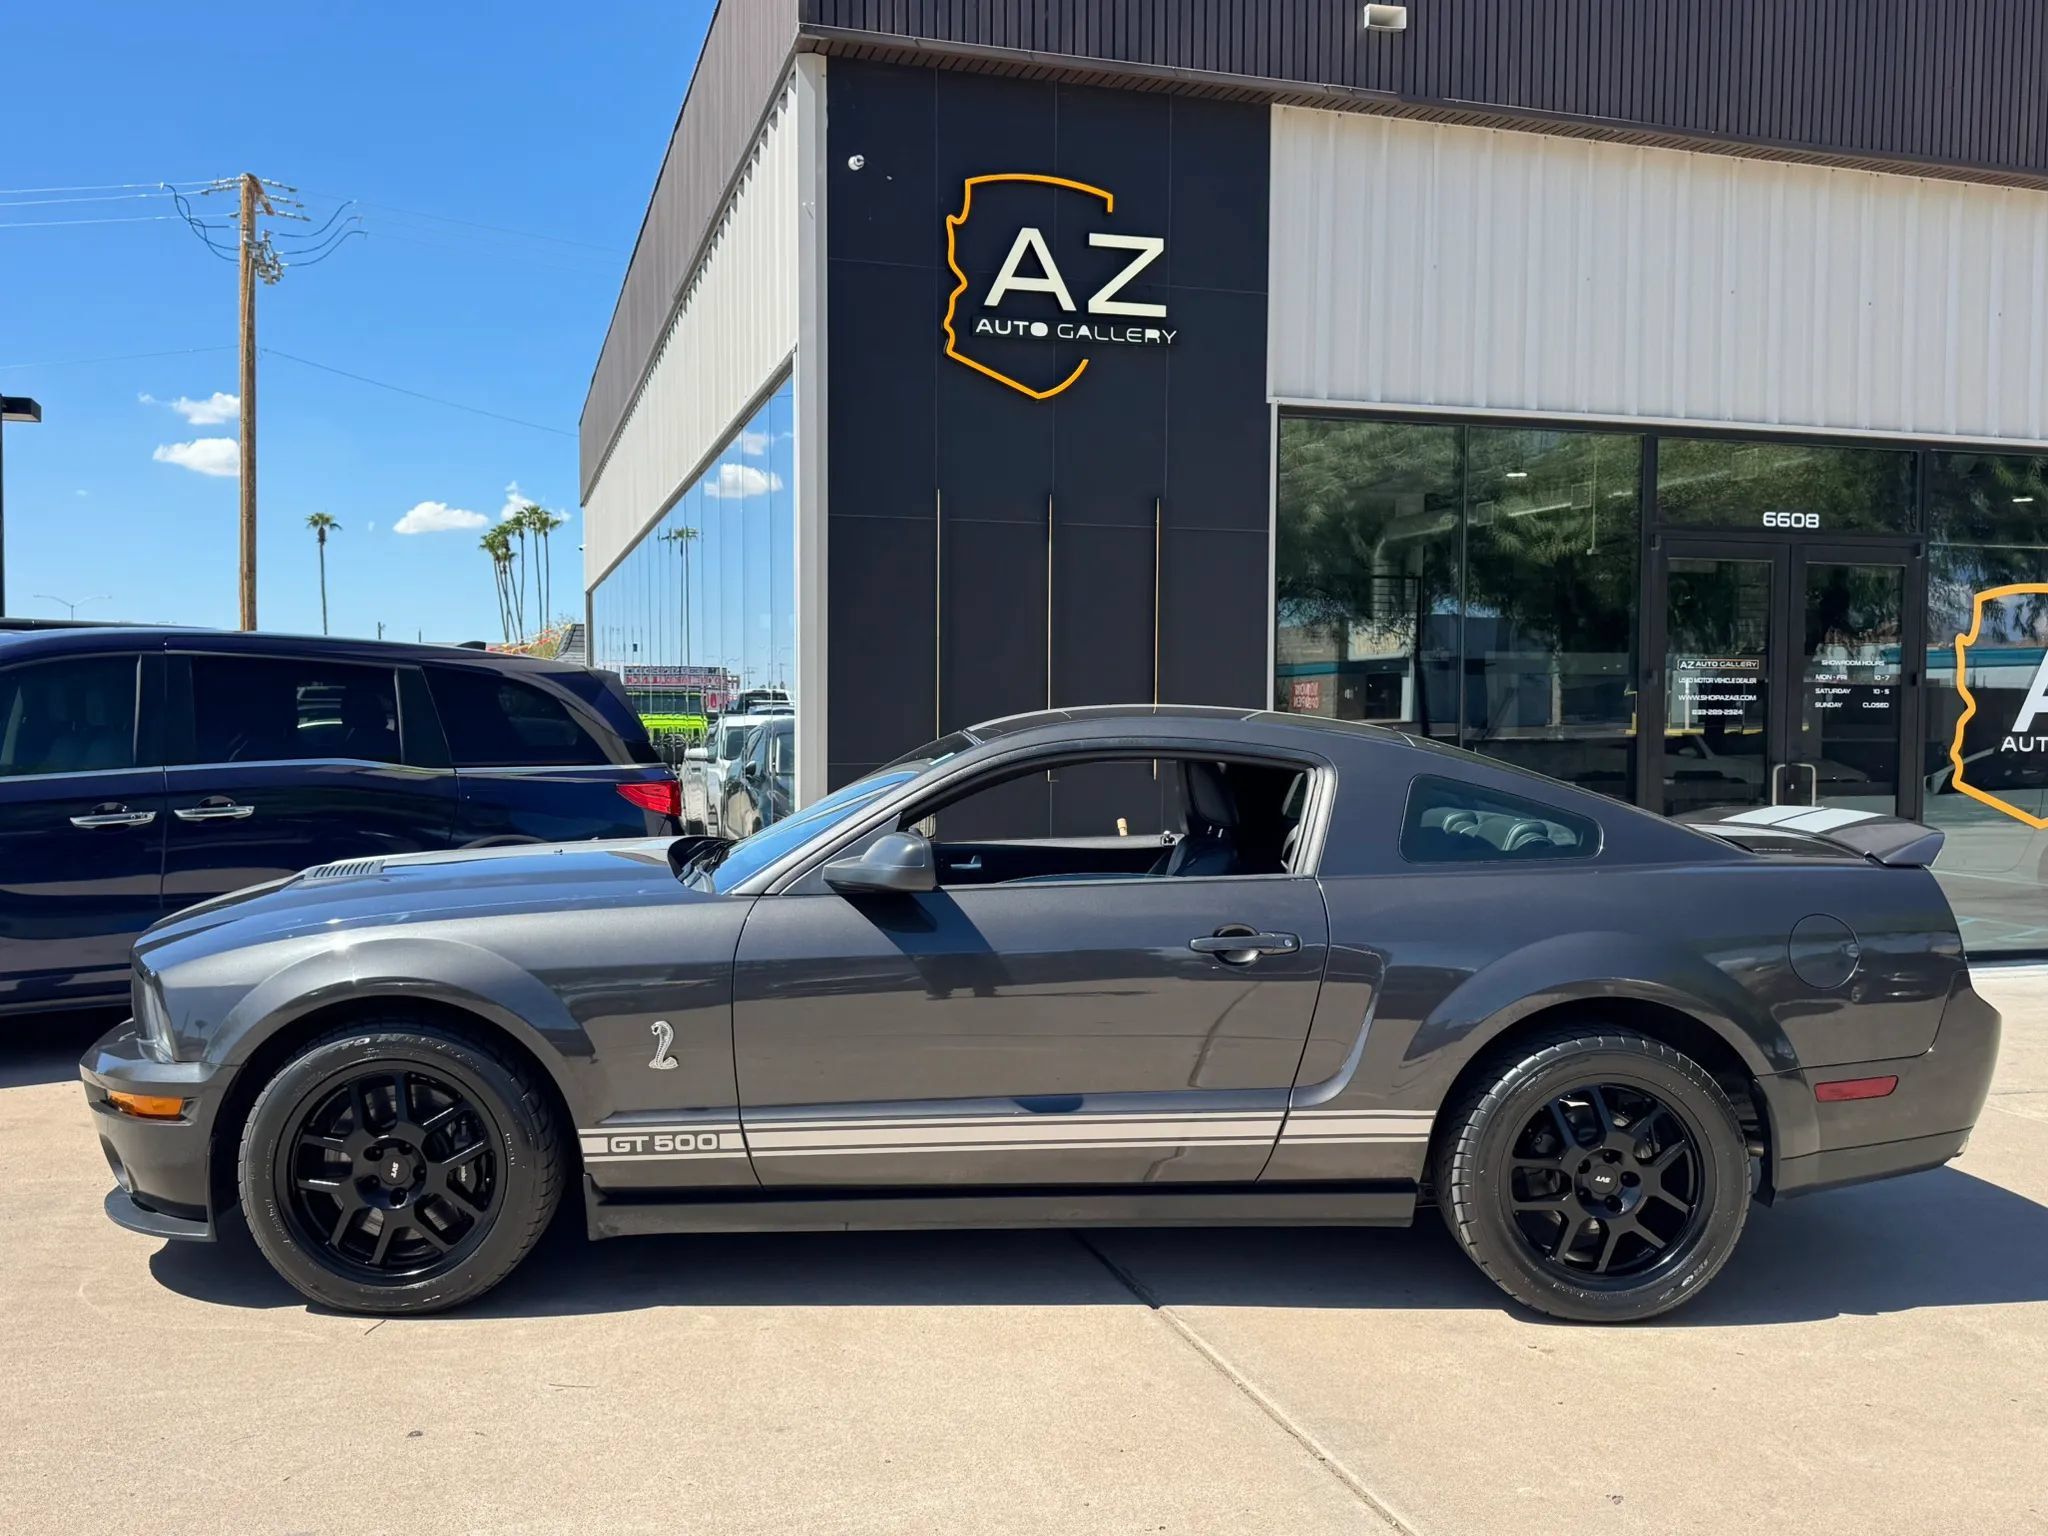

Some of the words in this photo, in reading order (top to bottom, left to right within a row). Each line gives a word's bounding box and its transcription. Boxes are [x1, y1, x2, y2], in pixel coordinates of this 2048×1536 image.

[984, 227, 1166, 317] AZ
[976, 319, 1049, 337] AUTO
[1057, 324, 1177, 344] GALLERY
[1763, 511, 1820, 528] 6608
[1680, 661, 1694, 669] AZ
[610, 1136, 649, 1153] GT
[654, 1134, 719, 1152] 500
